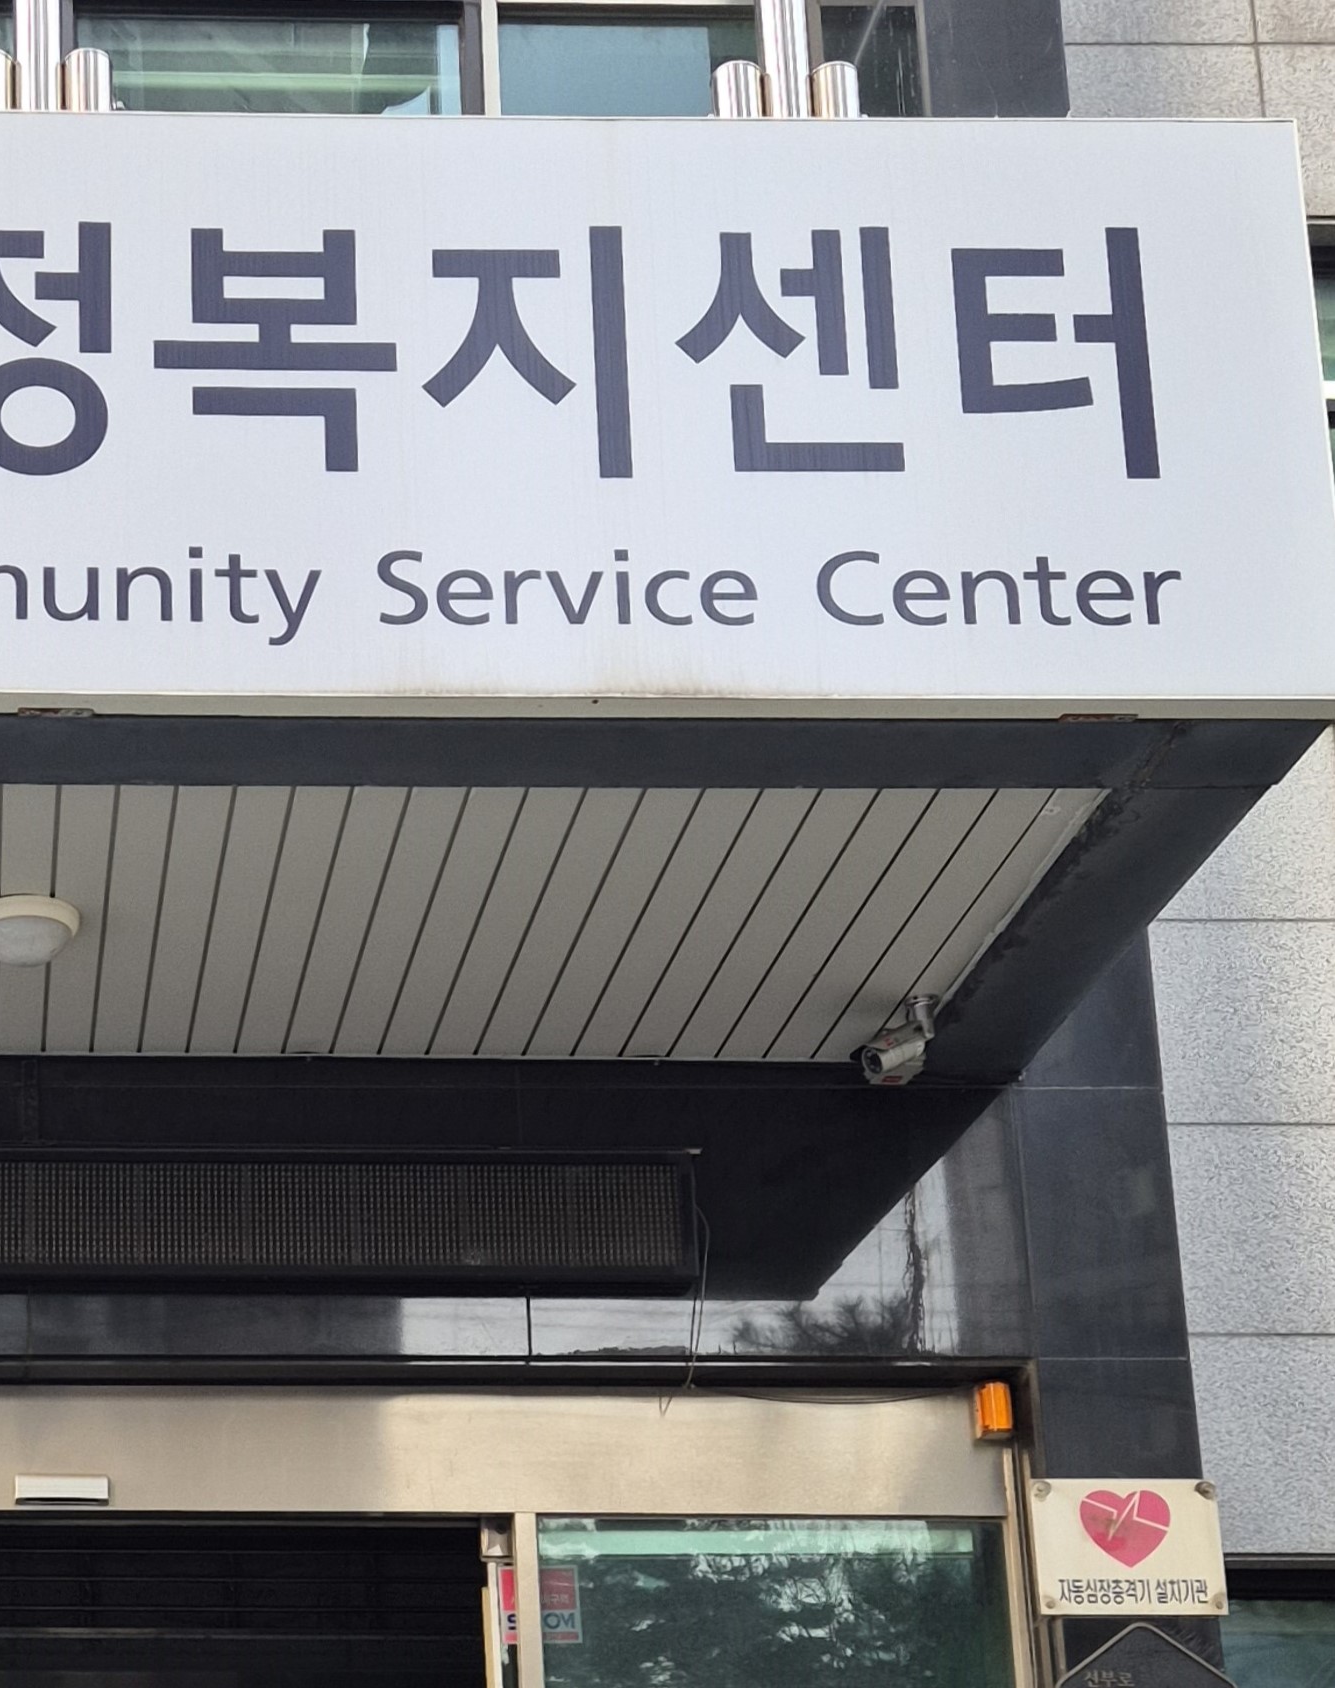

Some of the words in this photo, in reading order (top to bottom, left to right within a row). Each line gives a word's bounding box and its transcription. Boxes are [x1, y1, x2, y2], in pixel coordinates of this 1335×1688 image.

[378, 549, 757, 627] Service
[816, 550, 1181, 627] Center
[1058, 1579, 1152, 1604] 자동심장충격기
[1155, 1579, 1208, 1604] 설치기관
